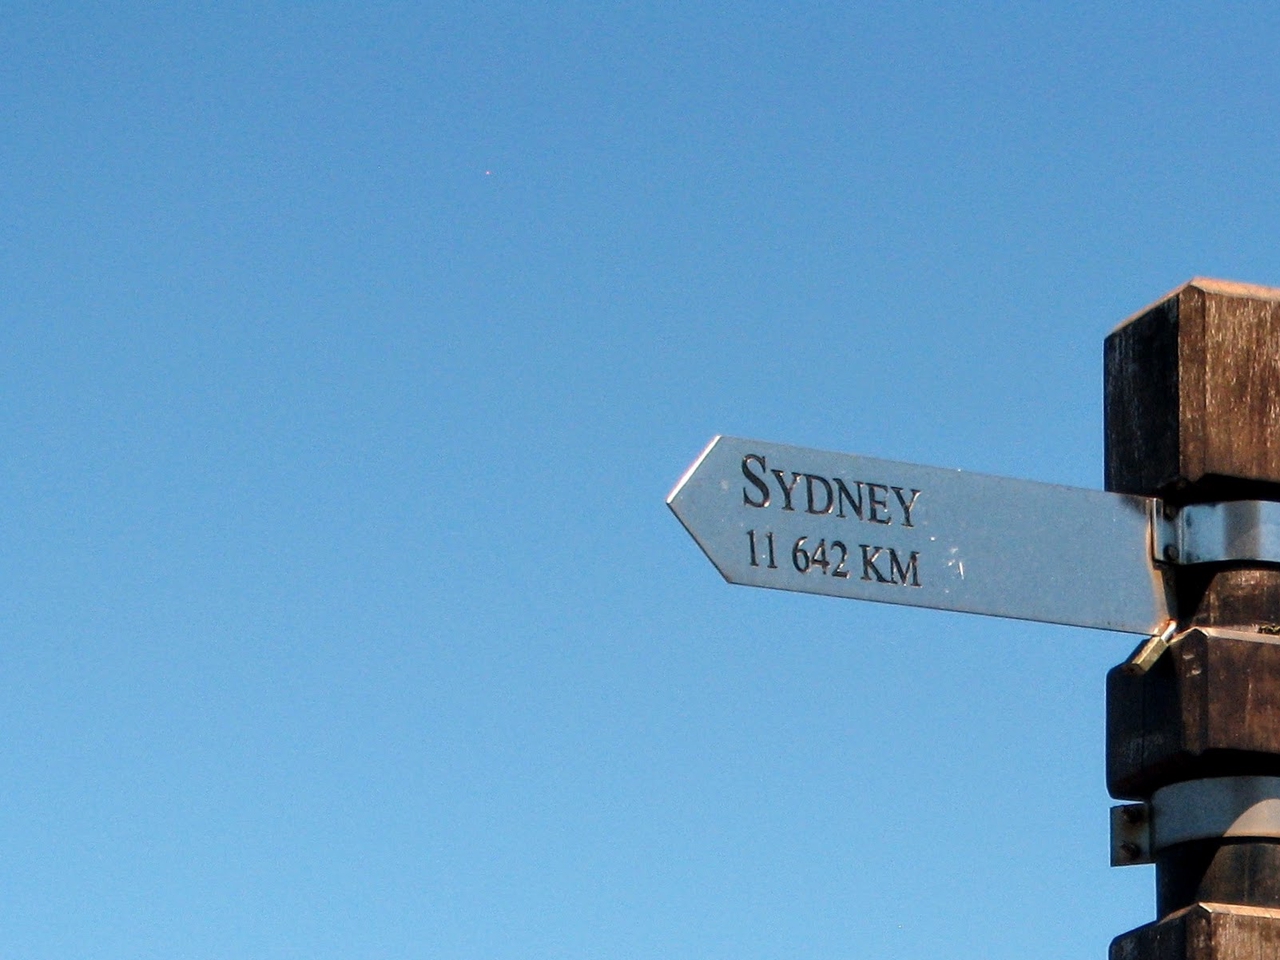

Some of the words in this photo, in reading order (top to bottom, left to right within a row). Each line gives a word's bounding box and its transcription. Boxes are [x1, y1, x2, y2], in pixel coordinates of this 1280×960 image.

[747, 528, 778, 569] 11
[792, 536, 850, 579] 642
[859, 544, 923, 588] KM
